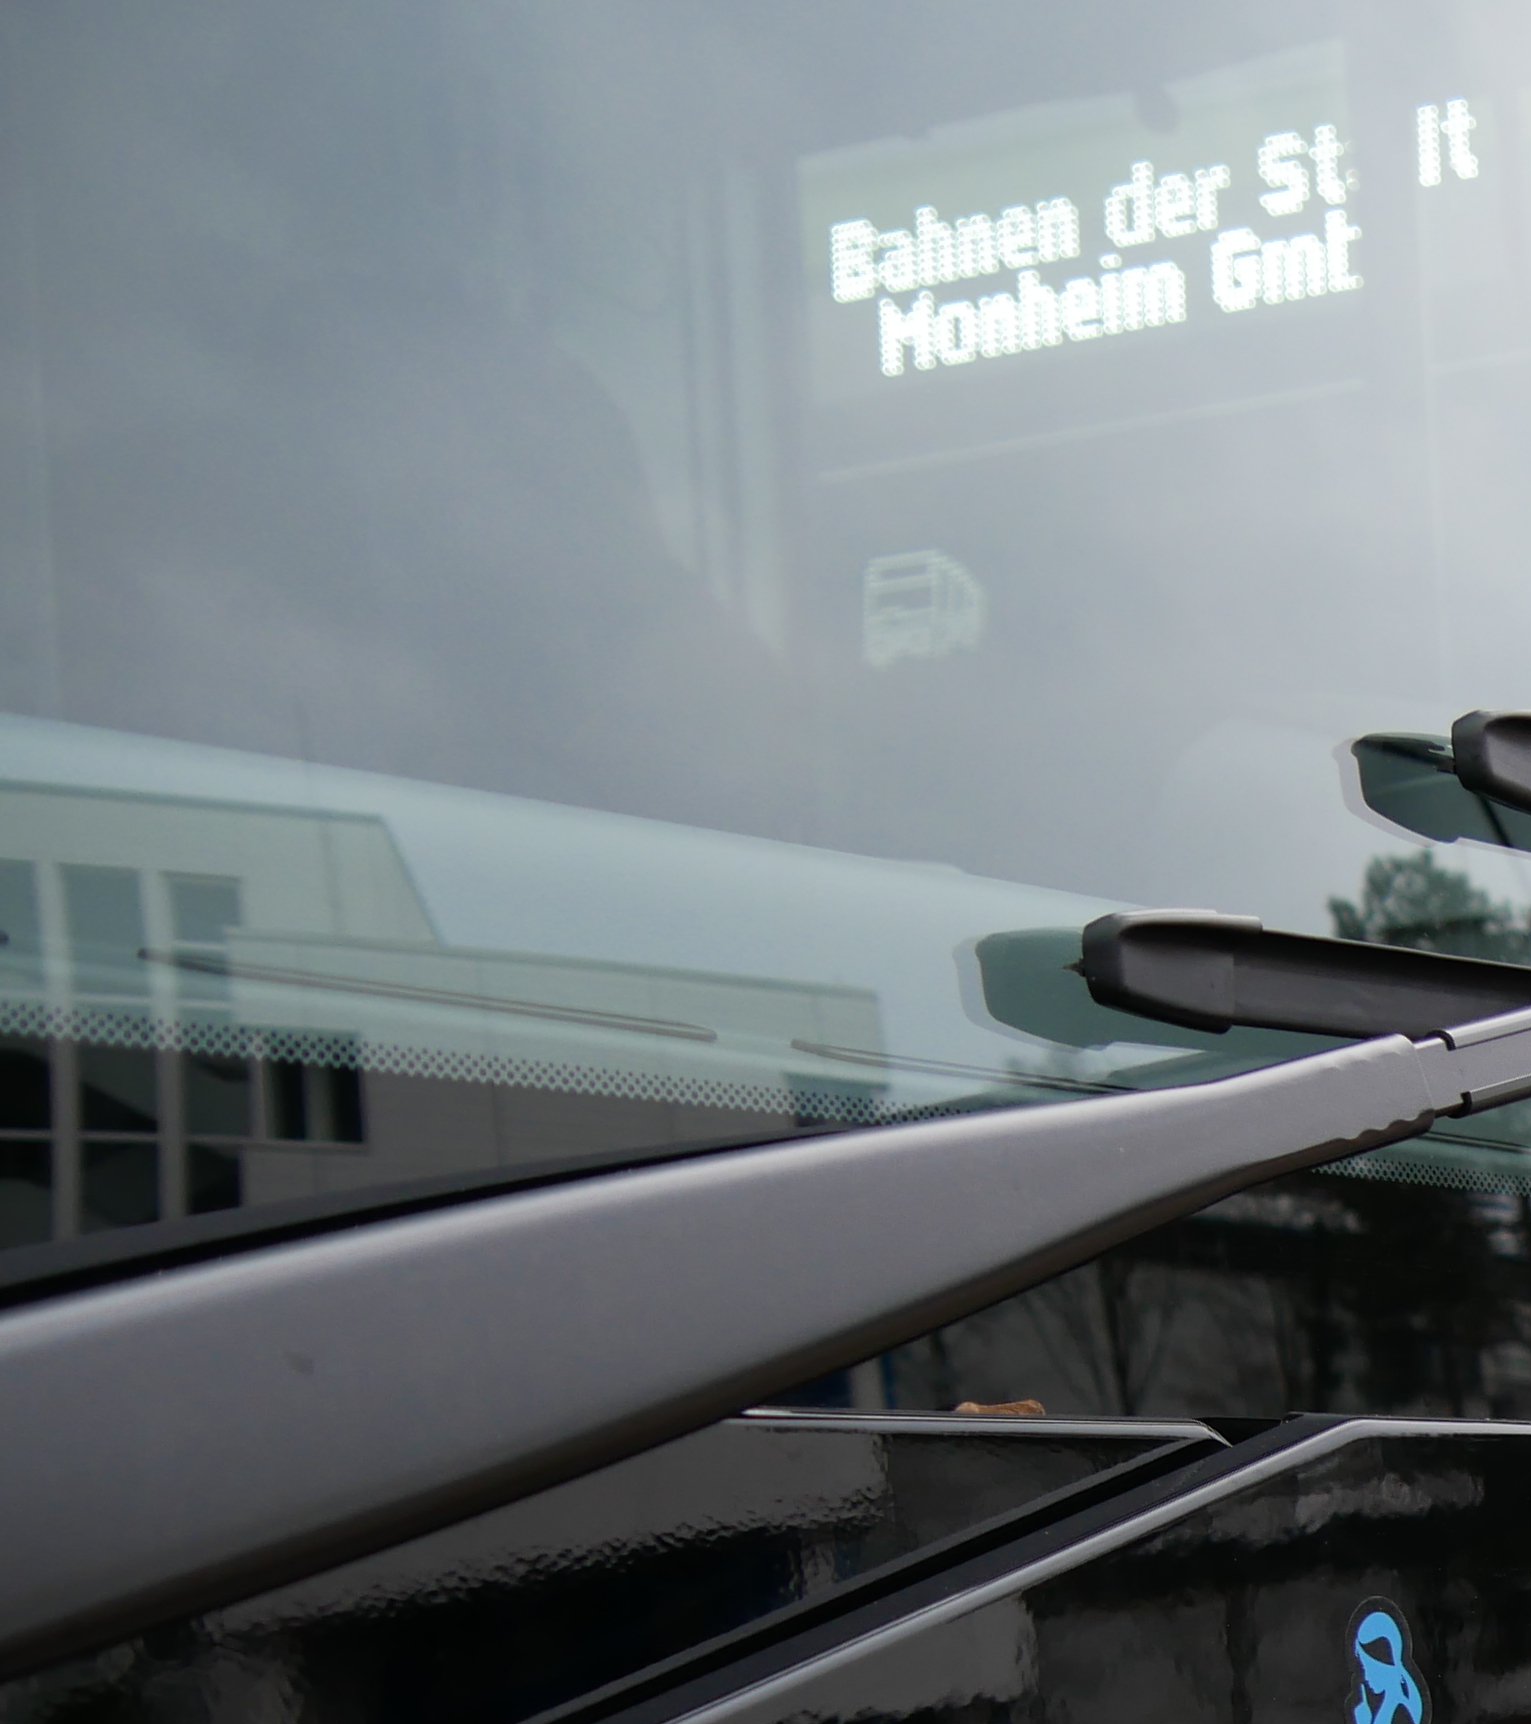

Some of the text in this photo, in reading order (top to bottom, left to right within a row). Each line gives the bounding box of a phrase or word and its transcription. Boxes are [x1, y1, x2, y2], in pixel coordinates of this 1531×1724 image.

[829, 196, 1081, 304] Bahnen
[1103, 160, 1231, 248] der
[878, 253, 1188, 378] Monheim
